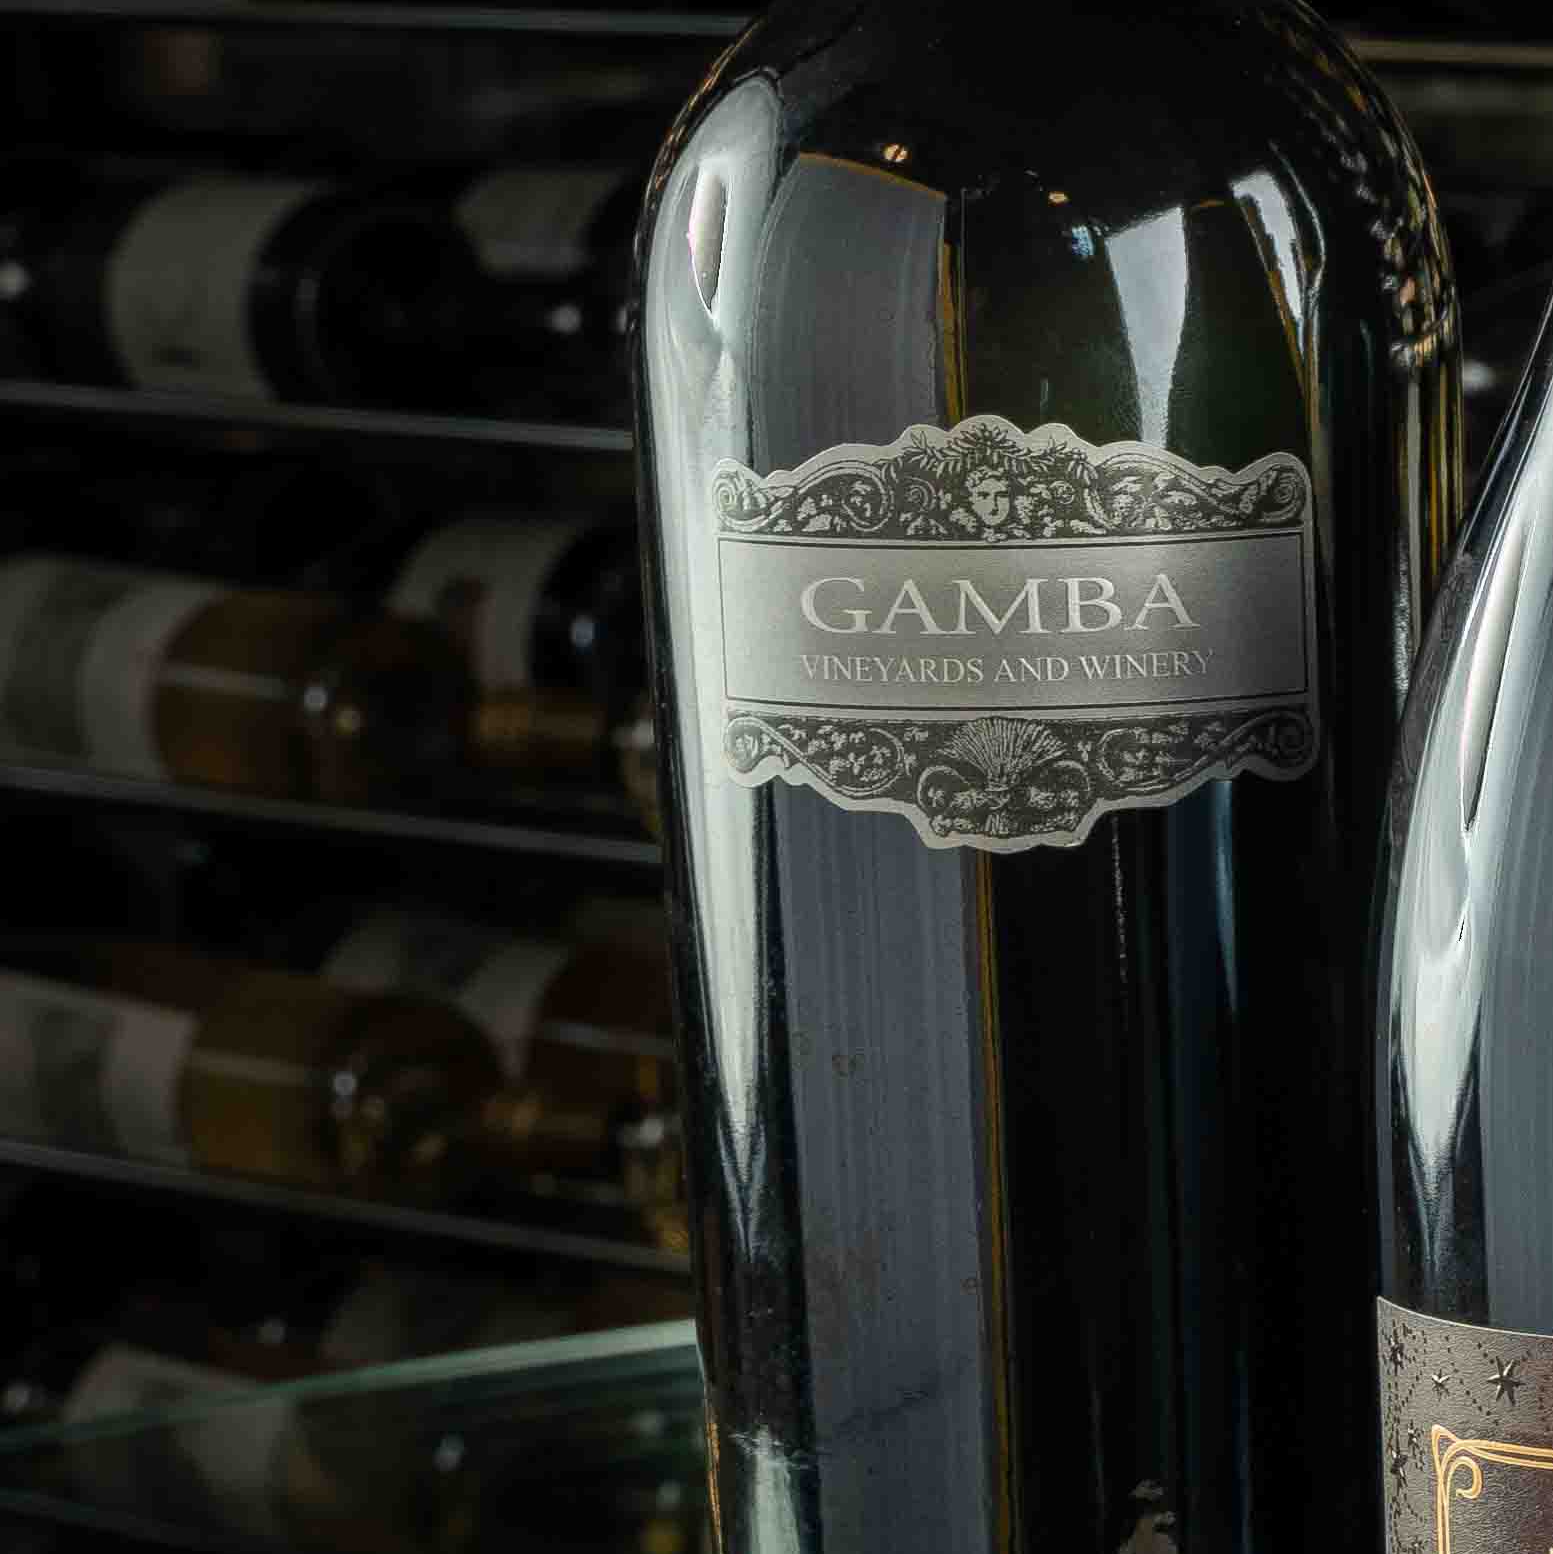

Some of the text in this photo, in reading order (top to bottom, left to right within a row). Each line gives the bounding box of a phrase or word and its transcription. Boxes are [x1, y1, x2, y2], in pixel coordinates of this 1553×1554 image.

[799, 573, 1203, 635] GAMBA
[798, 650, 1213, 684] VINEYARDS AND WINERY
